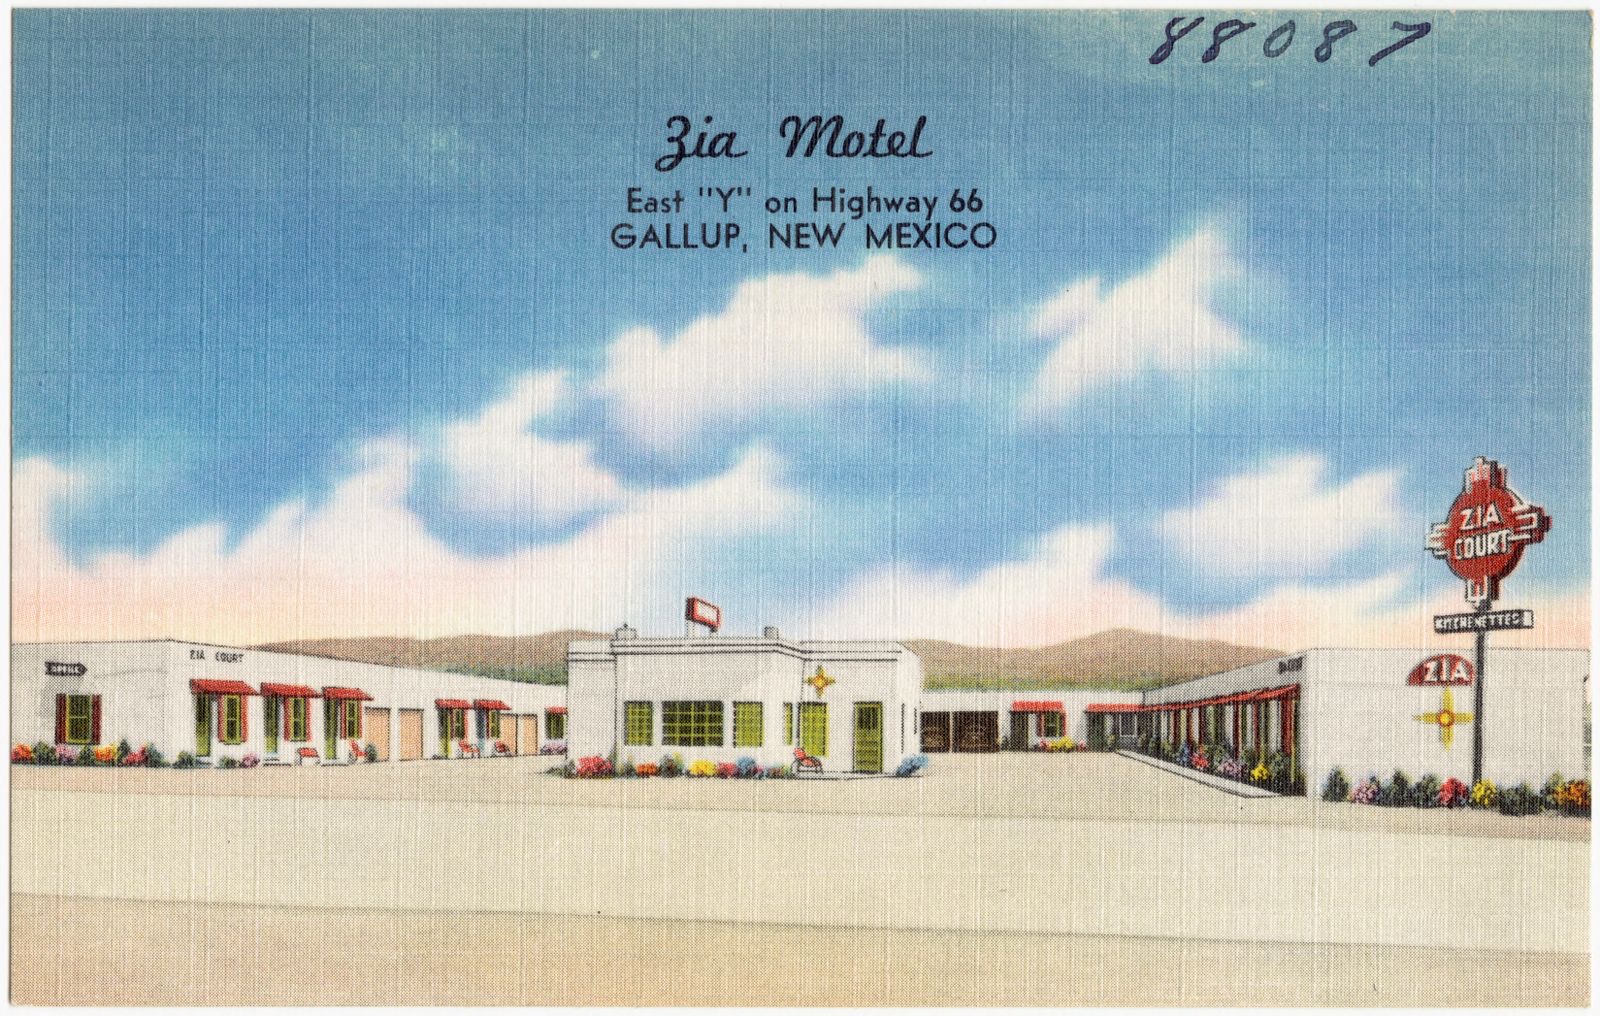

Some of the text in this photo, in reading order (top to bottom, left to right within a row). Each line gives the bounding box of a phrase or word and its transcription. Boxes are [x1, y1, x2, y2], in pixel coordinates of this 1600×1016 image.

[1149, 17, 1431, 66] 88087
[1459, 504, 1503, 531] ZIA
[1453, 530, 1510, 561] COURT
[1423, 660, 1471, 684] ZIA
